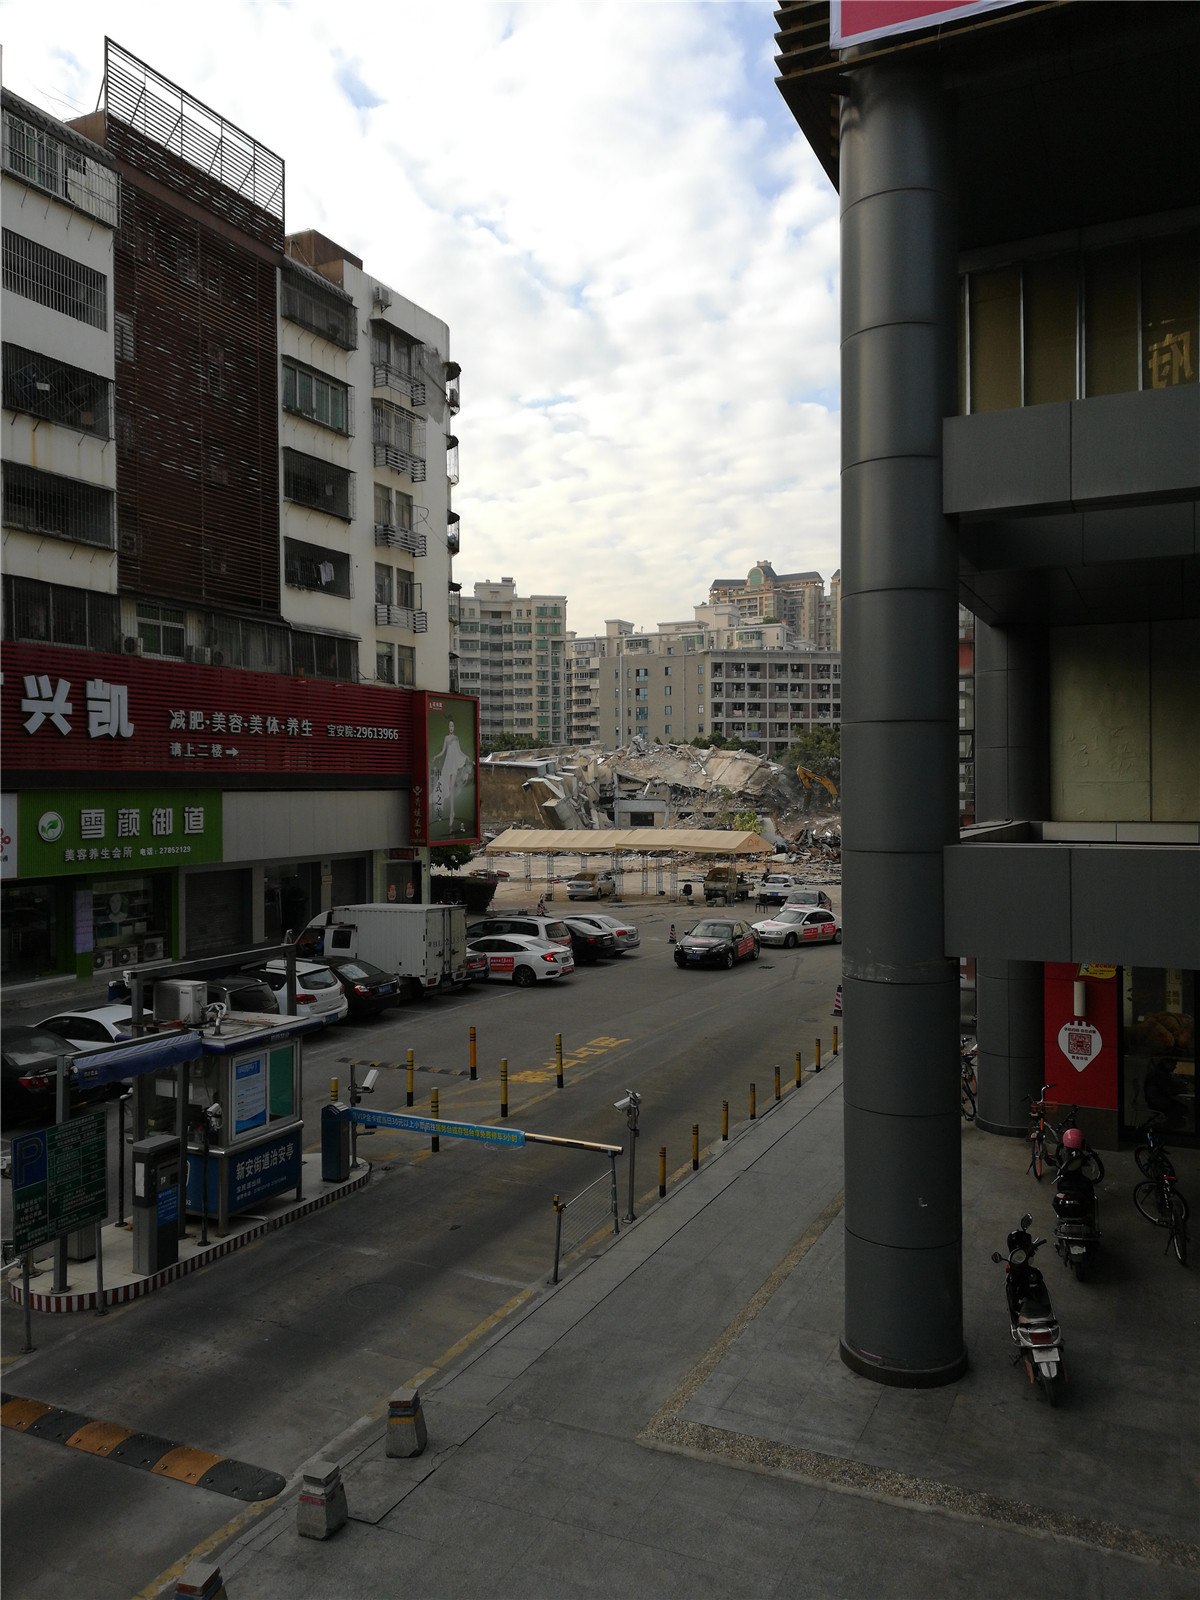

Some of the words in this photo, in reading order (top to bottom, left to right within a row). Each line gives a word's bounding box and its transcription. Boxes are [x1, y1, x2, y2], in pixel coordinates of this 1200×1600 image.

[20, 674, 134, 738] 兴凯
[168, 742, 223, 759] 请上二楼
[80, 806, 205, 839] 雪颜御道
[64, 847, 133, 862] 美容养生会所
[235, 1142, 295, 1181] 新安街道治安亭
